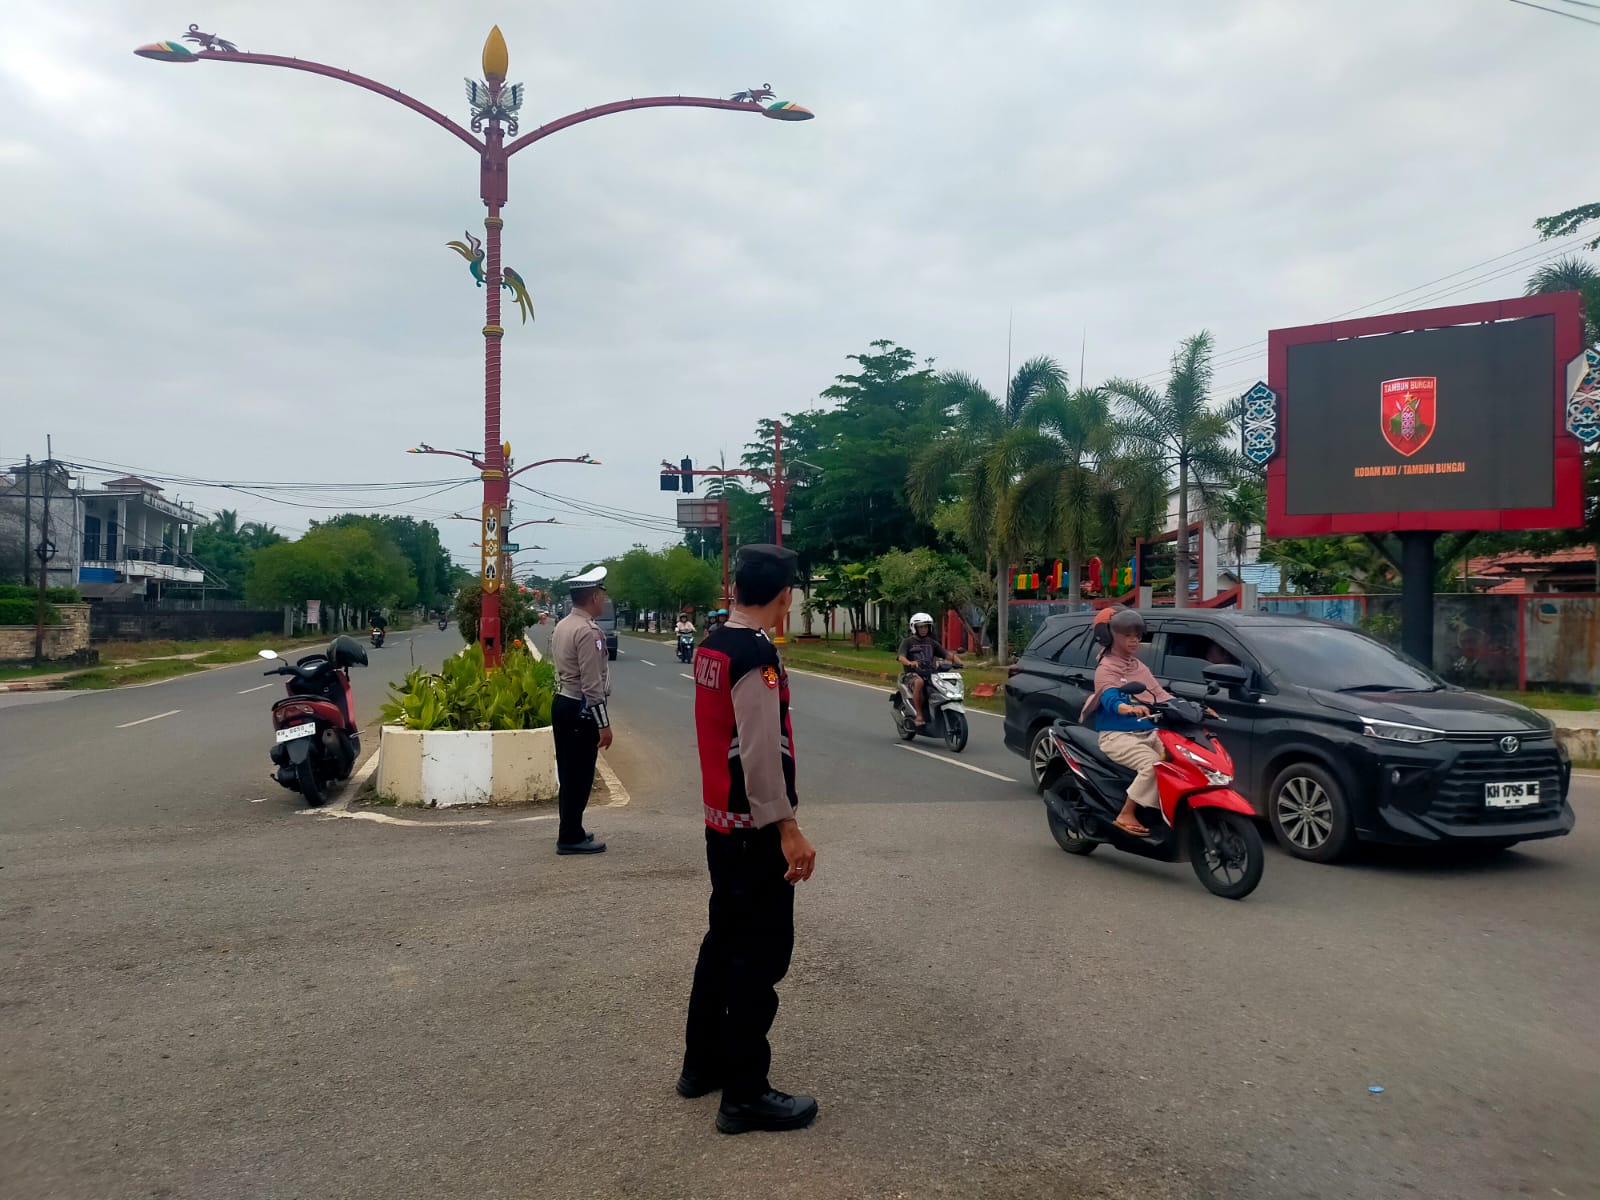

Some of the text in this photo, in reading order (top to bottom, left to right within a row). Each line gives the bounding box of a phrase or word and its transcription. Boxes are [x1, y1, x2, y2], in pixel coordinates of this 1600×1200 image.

[1384, 380, 1434, 393] TAMBUN BUNGAI
[1354, 466, 1381, 477] KODAM
[1403, 463, 1435, 475] TAMBUN
[1436, 462, 1465, 473] BUNGAI
[695, 655, 721, 689] POLISI
[1487, 785, 1500, 798] KH
